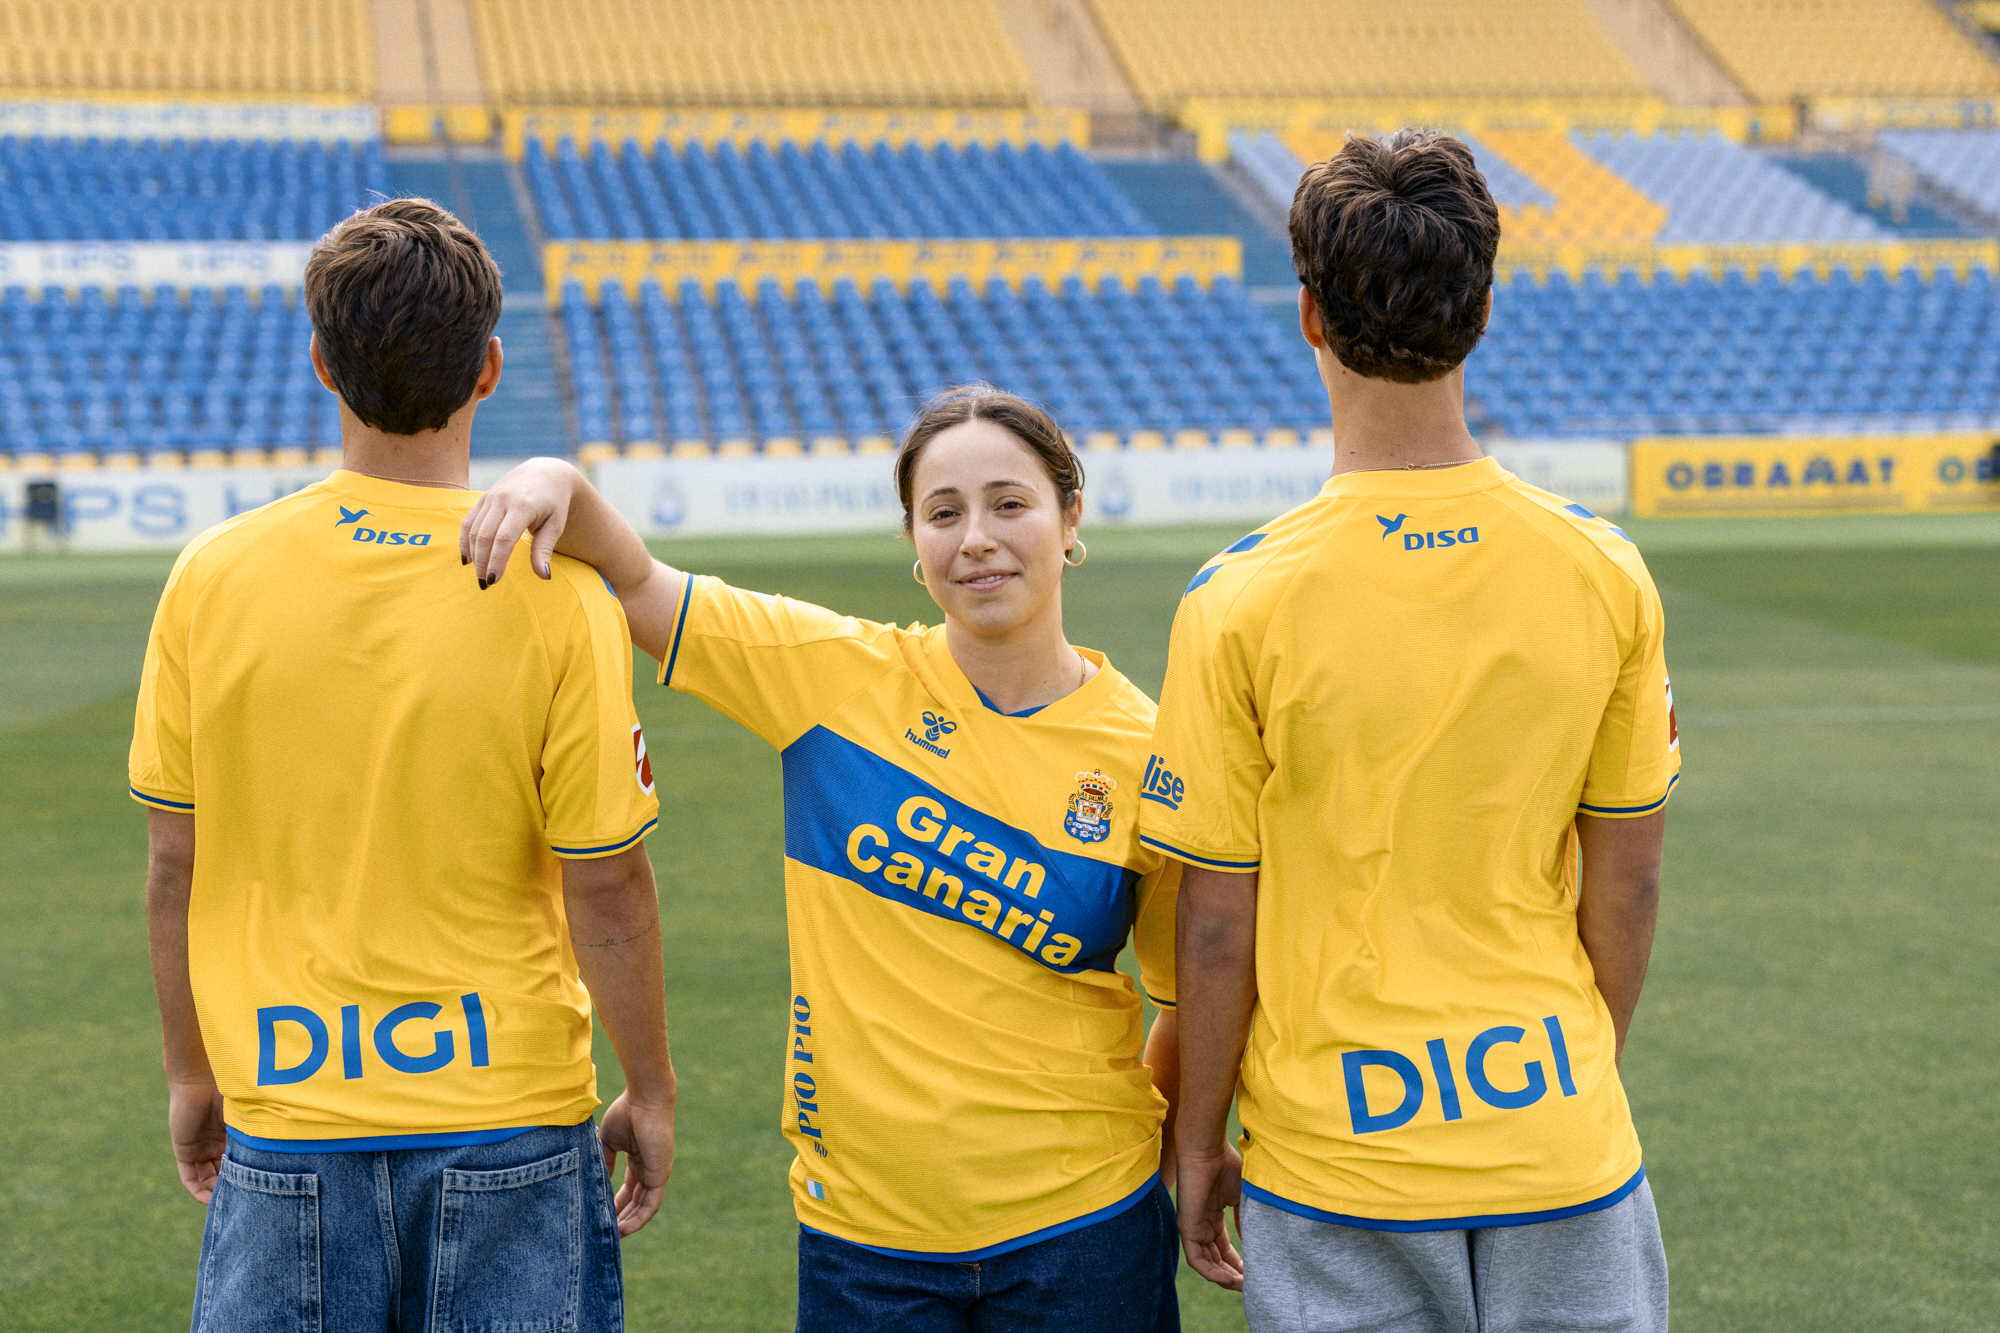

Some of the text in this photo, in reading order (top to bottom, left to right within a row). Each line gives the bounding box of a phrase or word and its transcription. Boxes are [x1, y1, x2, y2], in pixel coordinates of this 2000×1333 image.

[904, 728, 951, 759] hummel
[846, 823, 1082, 967] Canaria
[896, 795, 1047, 899] Gran
[257, 992, 490, 1087] DIGI
[1341, 1015, 1578, 1135] DIGI
